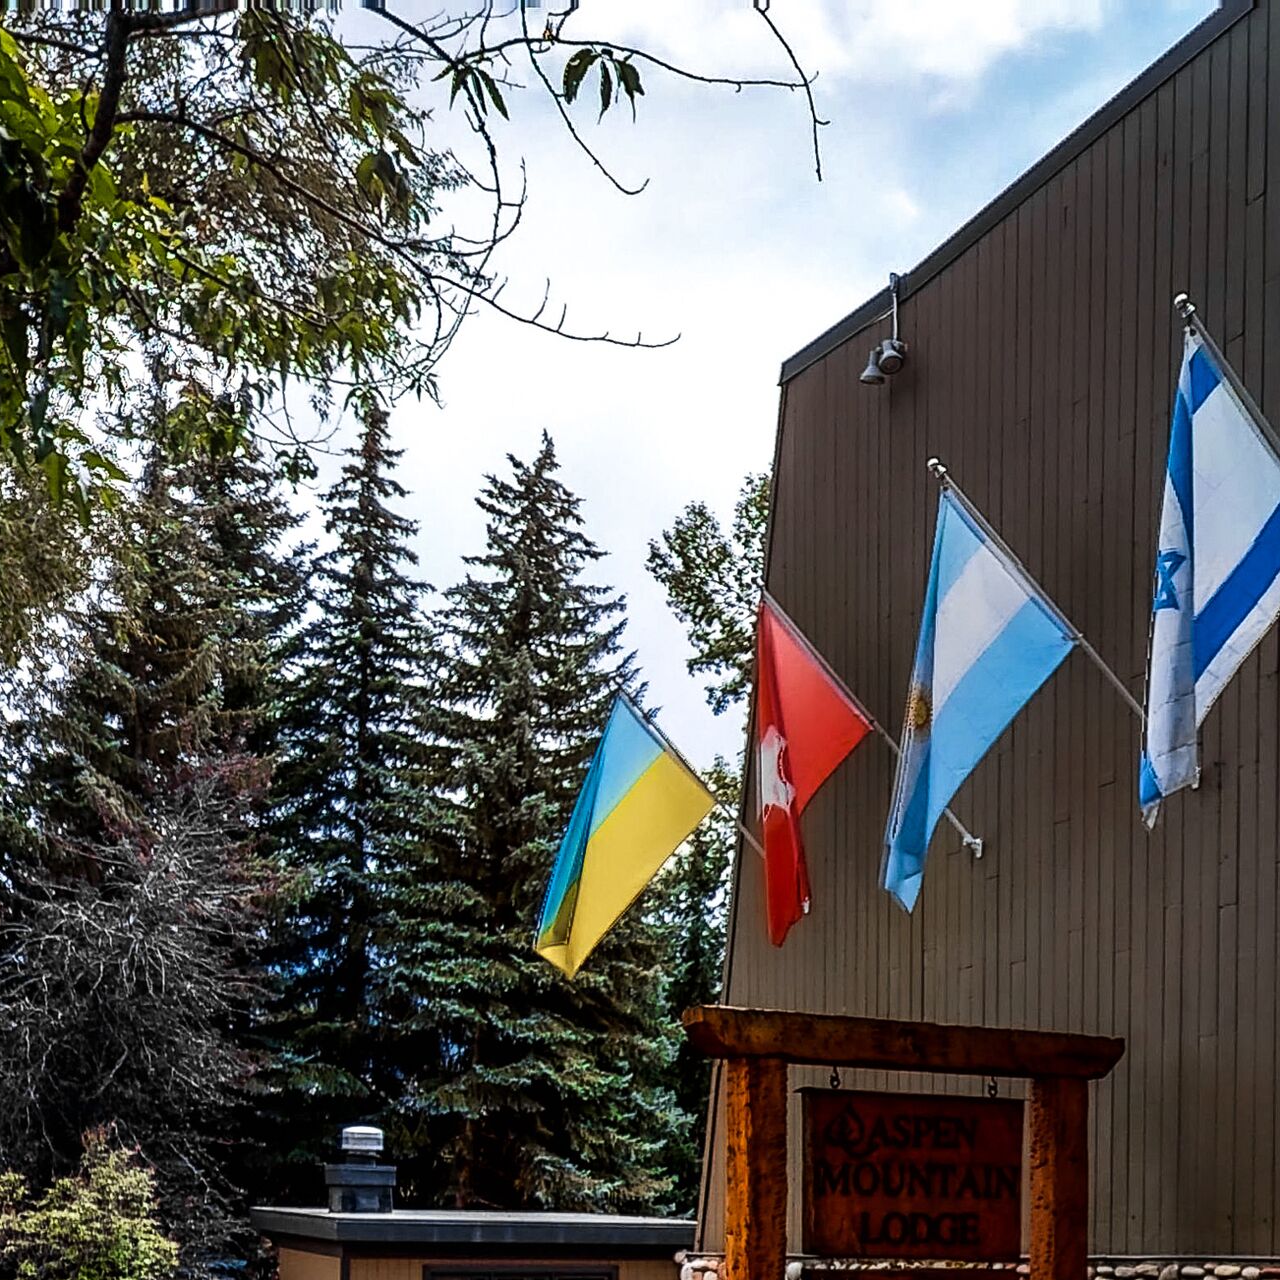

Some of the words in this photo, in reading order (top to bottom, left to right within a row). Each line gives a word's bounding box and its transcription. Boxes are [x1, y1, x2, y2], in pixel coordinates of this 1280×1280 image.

[868, 1113, 978, 1149] ASPEN
[815, 1156, 1019, 1200] MOUNTAIN
[859, 1211, 981, 1246] LODGE
